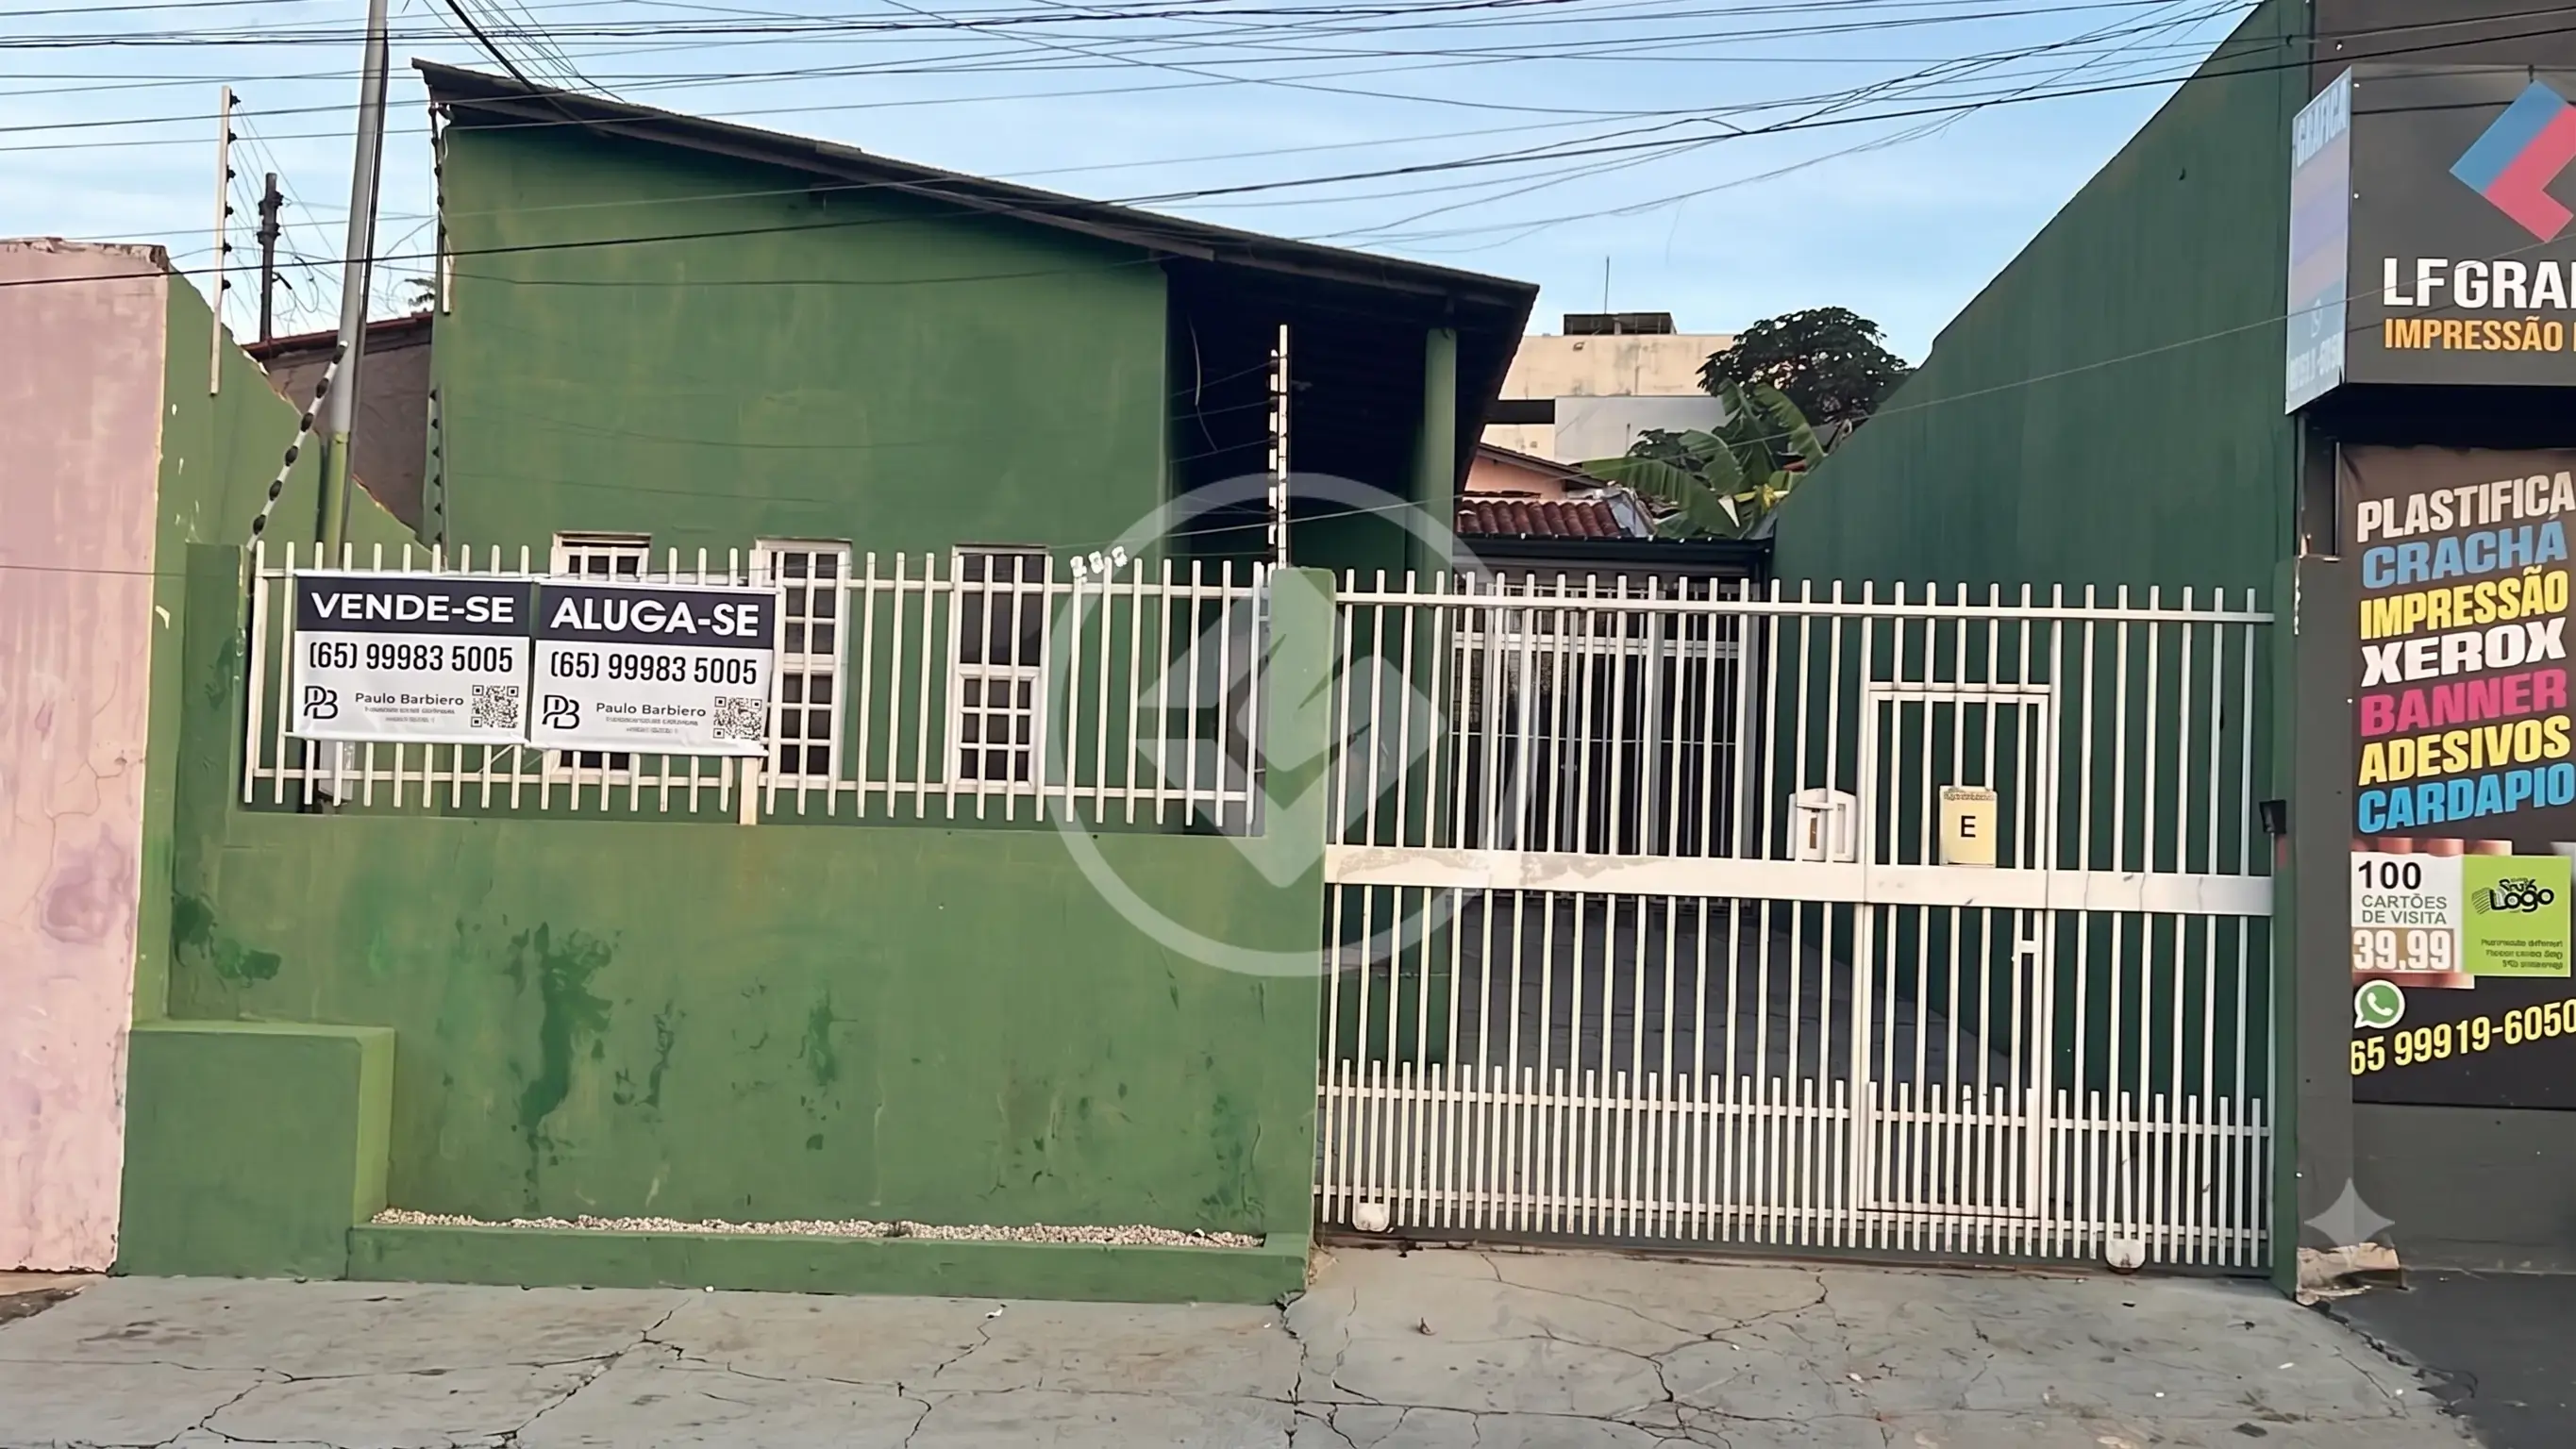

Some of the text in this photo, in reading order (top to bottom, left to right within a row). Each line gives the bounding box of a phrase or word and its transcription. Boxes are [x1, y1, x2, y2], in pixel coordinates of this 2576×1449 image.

[2384, 315, 2564, 352] IMPRESSÃO
[2357, 471, 2576, 542] PLASTIFICA
[2363, 512, 2568, 589] CRACHÁ
[311, 592, 514, 623] VENDE-SE
[550, 597, 760, 637] ALUGA-SE
[2360, 564, 2568, 640] IMPRESSÃO
[309, 642, 513, 673] (65) 99983 5005
[551, 651, 757, 685] (65) 99983 5005
[2361, 617, 2567, 687] XEROX
[355, 693, 464, 706] Paulo Barbiero
[596, 702, 707, 717] Paulo Barbiero
[2361, 668, 2568, 737] BANNER
[2358, 715, 2570, 786] ADESIVOS
[2358, 762, 2575, 834] CARDAPIO
[1961, 815, 1976, 838] E
[2358, 860, 2421, 890] 100
[2361, 893, 2448, 909] CARTÕES
[2362, 910, 2447, 924] DE VISITA
[2350, 998, 2576, 1075] 65 99919-6050
